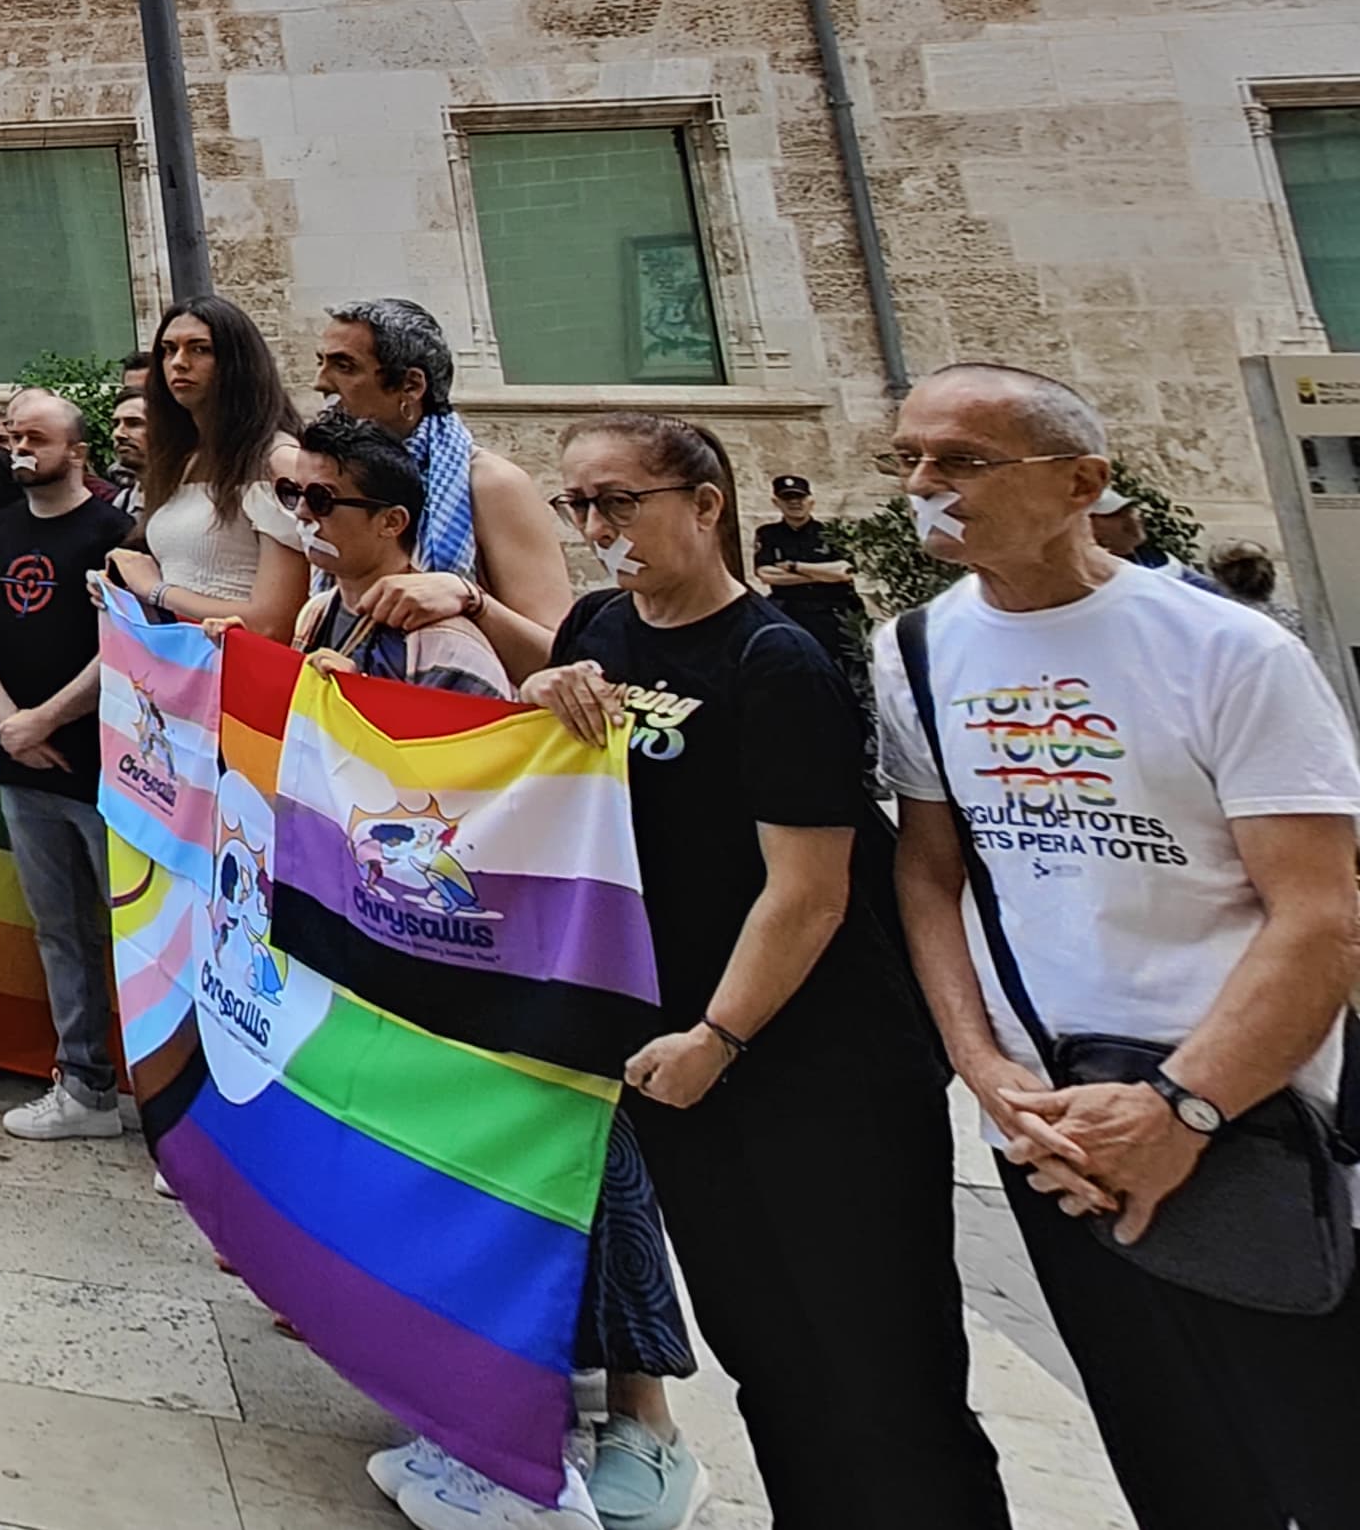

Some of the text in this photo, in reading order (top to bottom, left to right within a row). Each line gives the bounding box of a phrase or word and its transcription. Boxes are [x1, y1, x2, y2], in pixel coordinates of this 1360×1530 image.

[623, 679, 704, 729] eing
[962, 805, 1038, 828] GULL
[972, 830, 1189, 866] ETS PER A TOTES
[353, 885, 495, 948] Chrysallis
